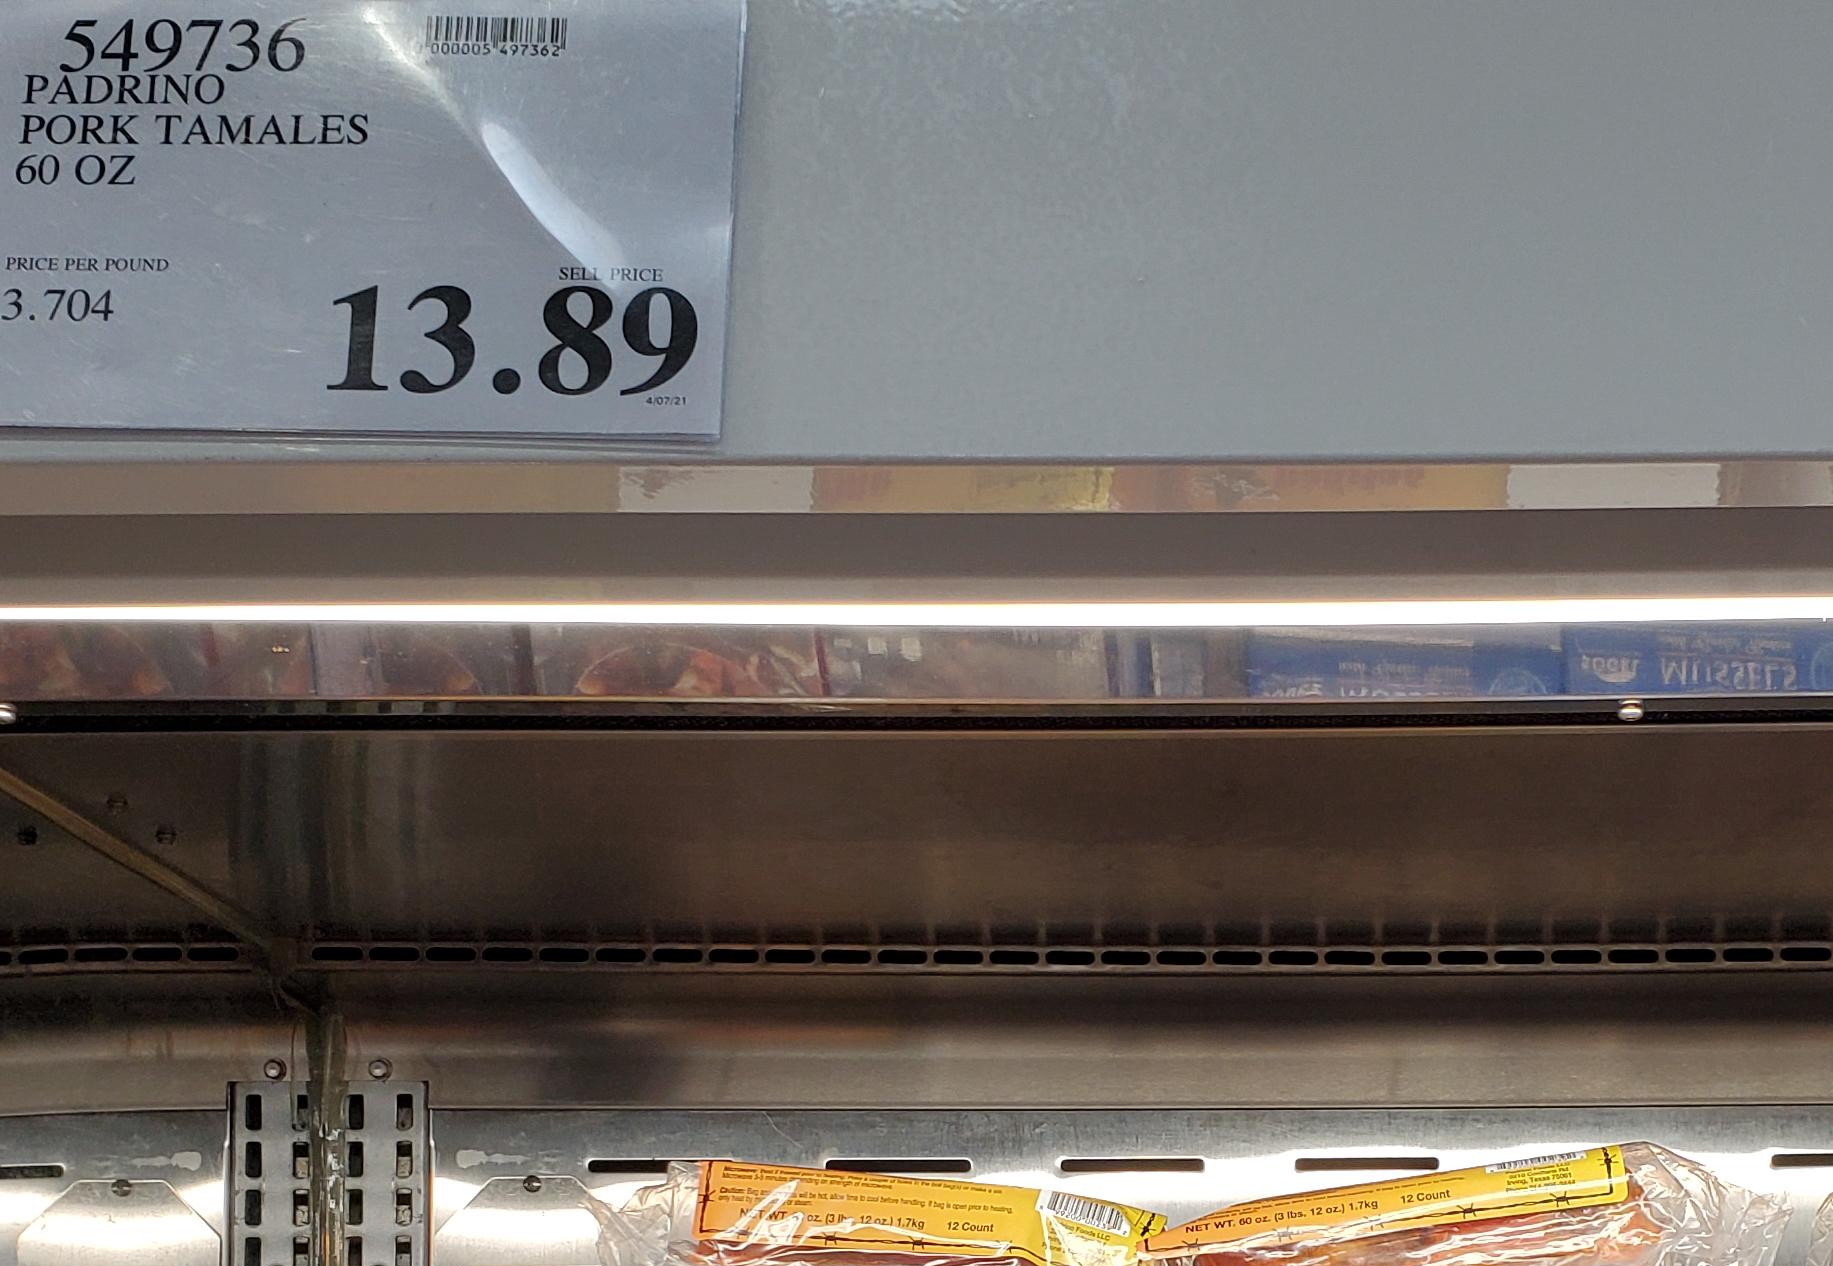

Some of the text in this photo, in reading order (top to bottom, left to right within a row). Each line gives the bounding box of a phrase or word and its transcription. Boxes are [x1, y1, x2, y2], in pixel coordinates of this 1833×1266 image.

[59, 18, 307, 72] 549736
[431, 42, 560, 57] 000005 497362
[22, 73, 225, 105] PADRINO
[19, 113, 369, 145] PORK TAMALES
[15, 154, 136, 185] 60 OZ
[5, 256, 169, 272] PRICE PER POUND
[558, 266, 664, 282] SELL PRICE
[1, 288, 114, 322] 3.704
[326, 284, 699, 396] 13.89
[645, 396, 687, 406] 4/07/21
[897, 1217, 925, 1230] 1.7kg
[947, 1221, 960, 1231] 12
[962, 1222, 994, 1233] Count
[1185, 1223, 1209, 1233] NET
[1214, 1218, 1236, 1230] WT.
[1239, 1216, 1253, 1225] 60
[1255, 1214, 1271, 1223] oz.
[1274, 1210, 1285, 1222] (3
[1287, 1207, 1307, 1219] lbs.
[1310, 1206, 1323, 1217] 12
[1349, 1200, 1378, 1212] 1.7kg
[1400, 1194, 1414, 1204] 12
[1417, 1189, 1451, 1201] Count
[1097, 1231, 1111, 1242] LLC
